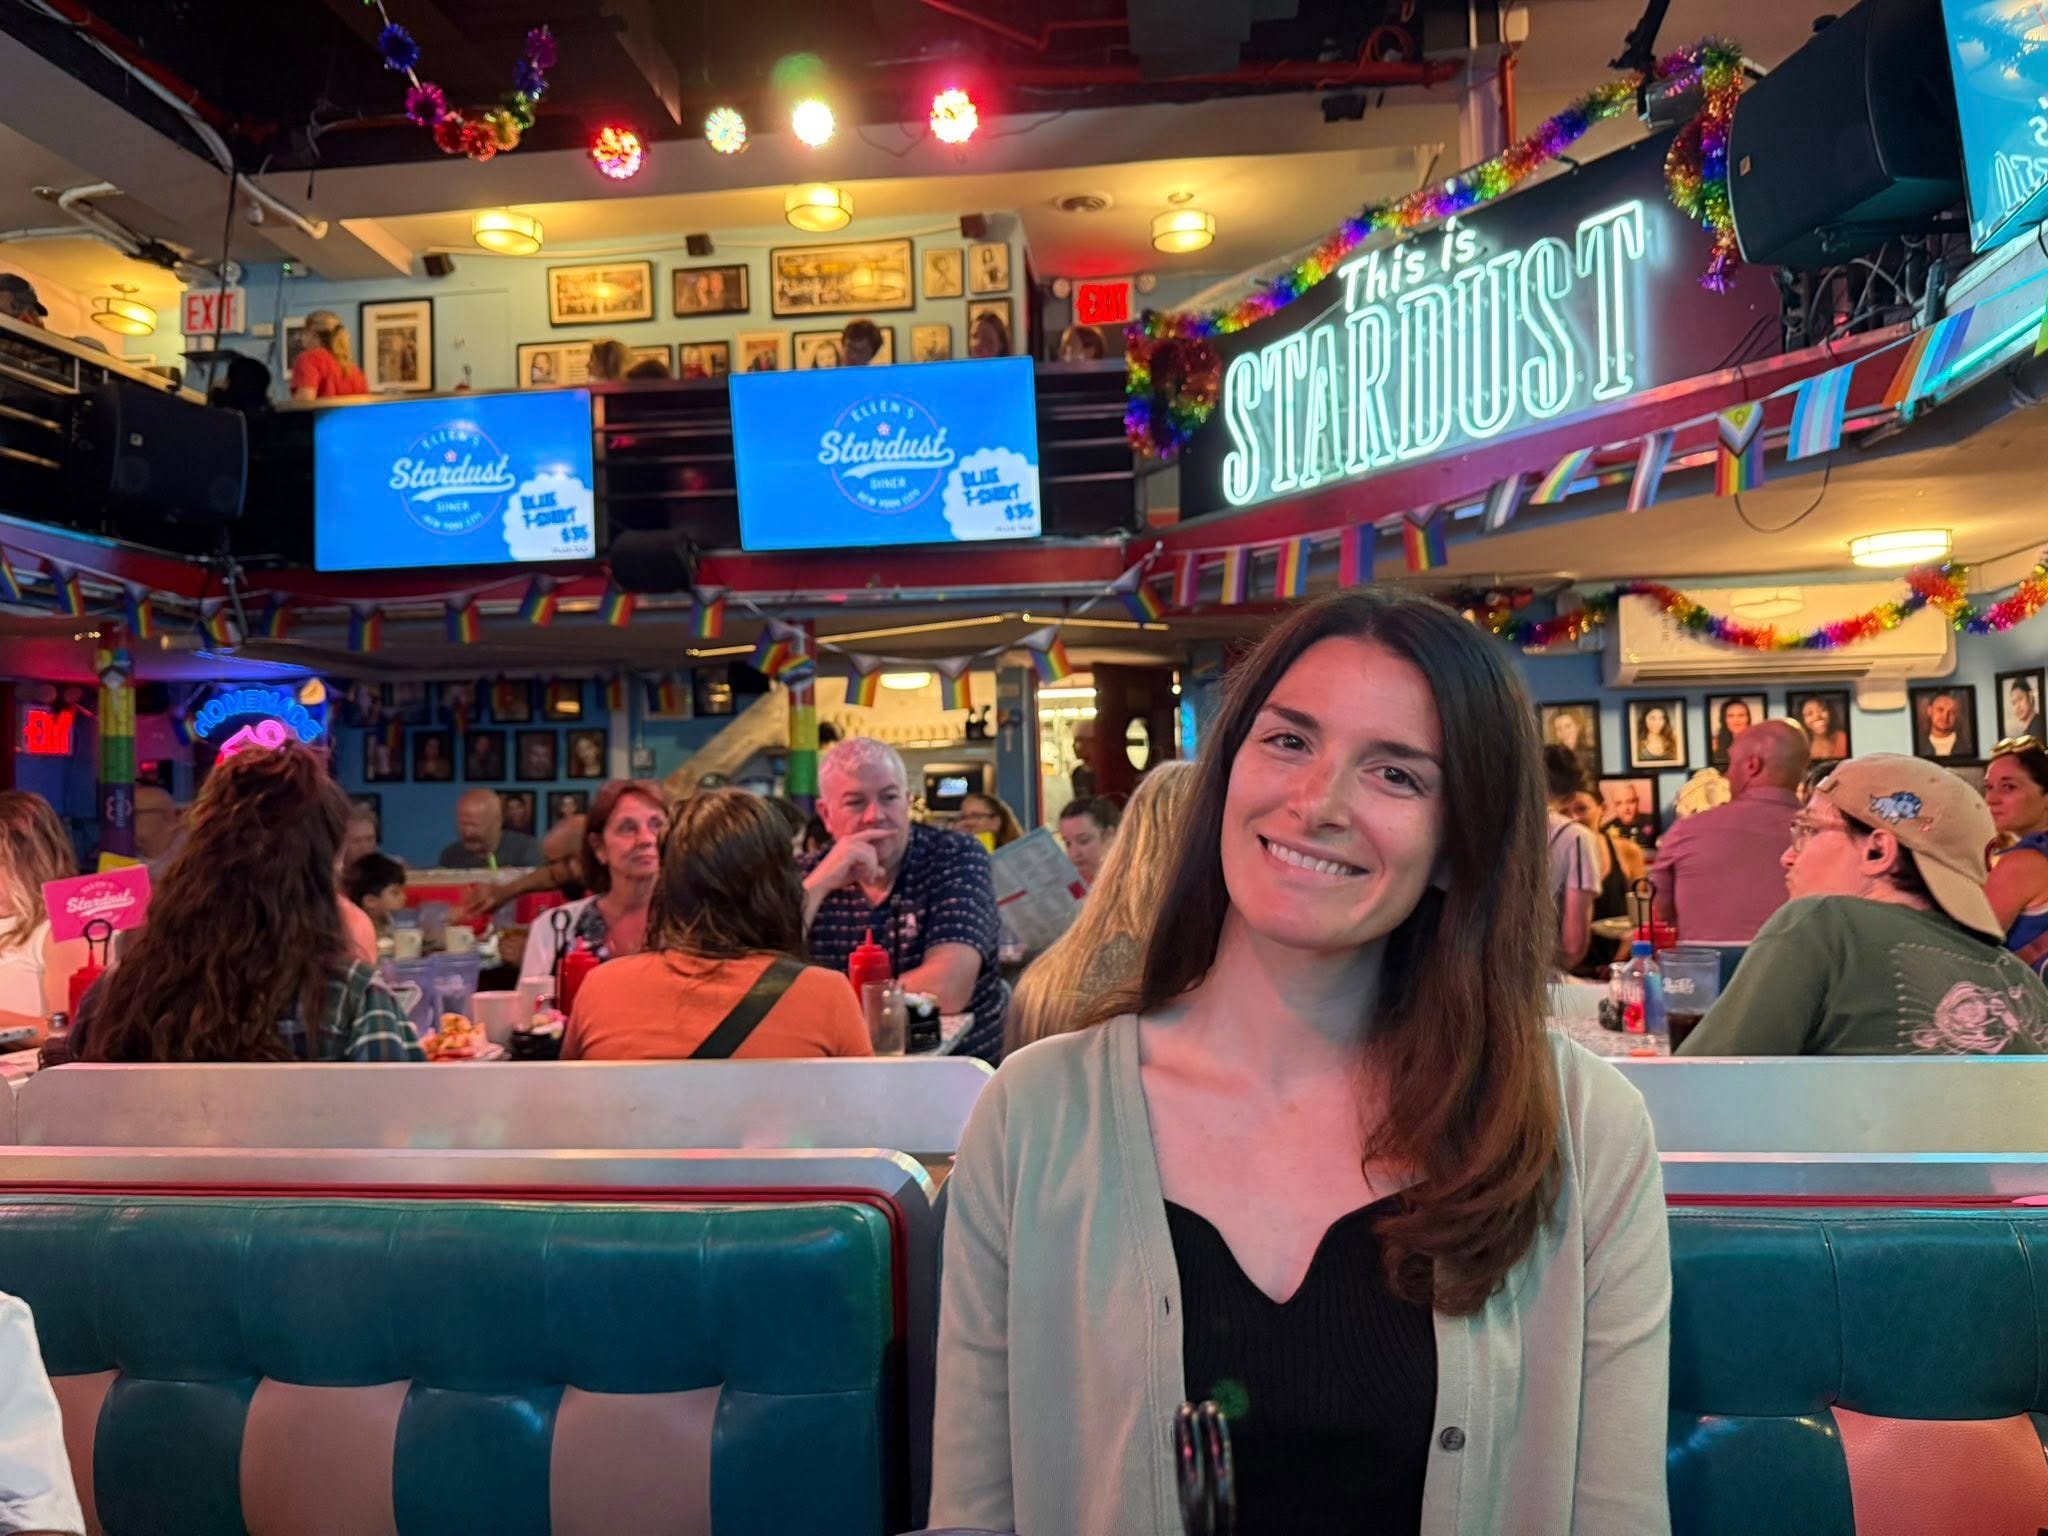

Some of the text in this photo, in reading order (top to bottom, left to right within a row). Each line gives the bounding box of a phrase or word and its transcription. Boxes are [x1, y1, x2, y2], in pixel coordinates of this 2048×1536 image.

[1338, 215, 1480, 314] This is
[186, 293, 235, 331] EXT
[1222, 200, 1645, 506] STARDUST
[818, 426, 950, 466] Stardust
[389, 453, 514, 491] Stardust
